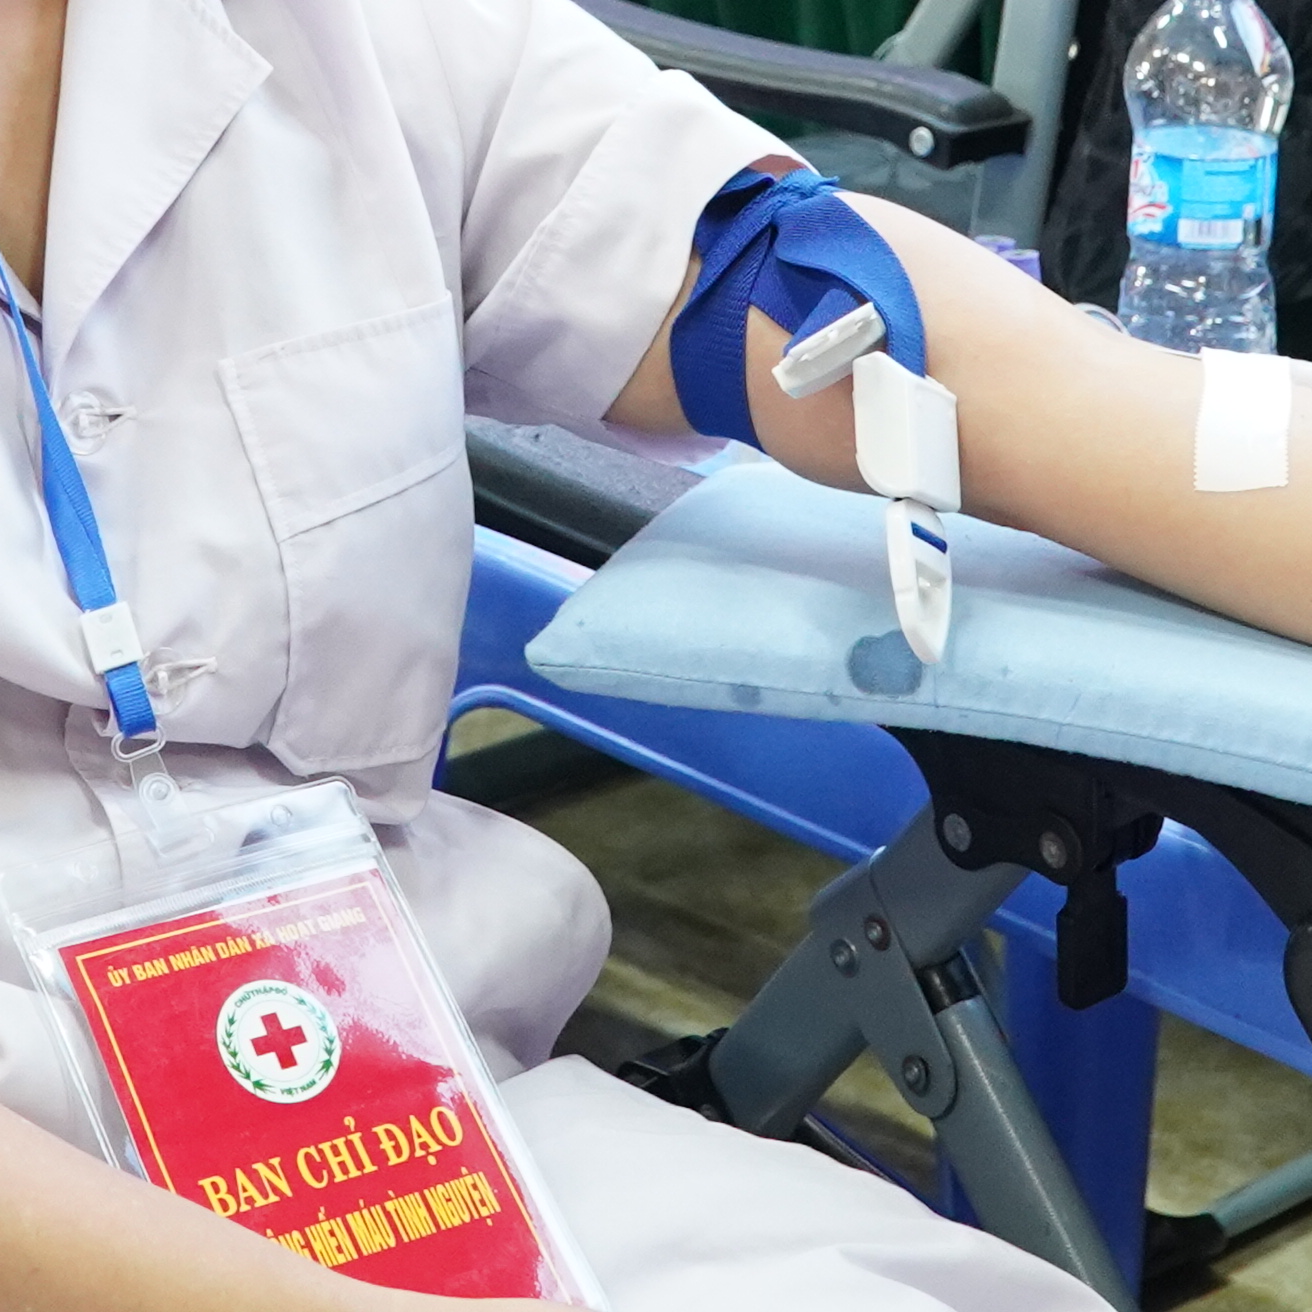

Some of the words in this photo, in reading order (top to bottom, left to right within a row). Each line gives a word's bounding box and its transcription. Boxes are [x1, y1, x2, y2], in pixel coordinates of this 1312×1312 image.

[106, 965, 131, 988] ỦY
[132, 957, 170, 982] BAN
[170, 946, 216, 973] NHÂN
[217, 935, 252, 960] DÂN
[198, 1157, 293, 1219] BAN
[296, 1116, 379, 1189] CHỈ
[372, 1106, 464, 1166] ĐẠO
[304, 1206, 359, 1268] HIẾN
[346, 1199, 396, 1256] MÁU
[384, 1190, 437, 1243] TÌNH
[423, 1166, 502, 1230] NGUYỆN
